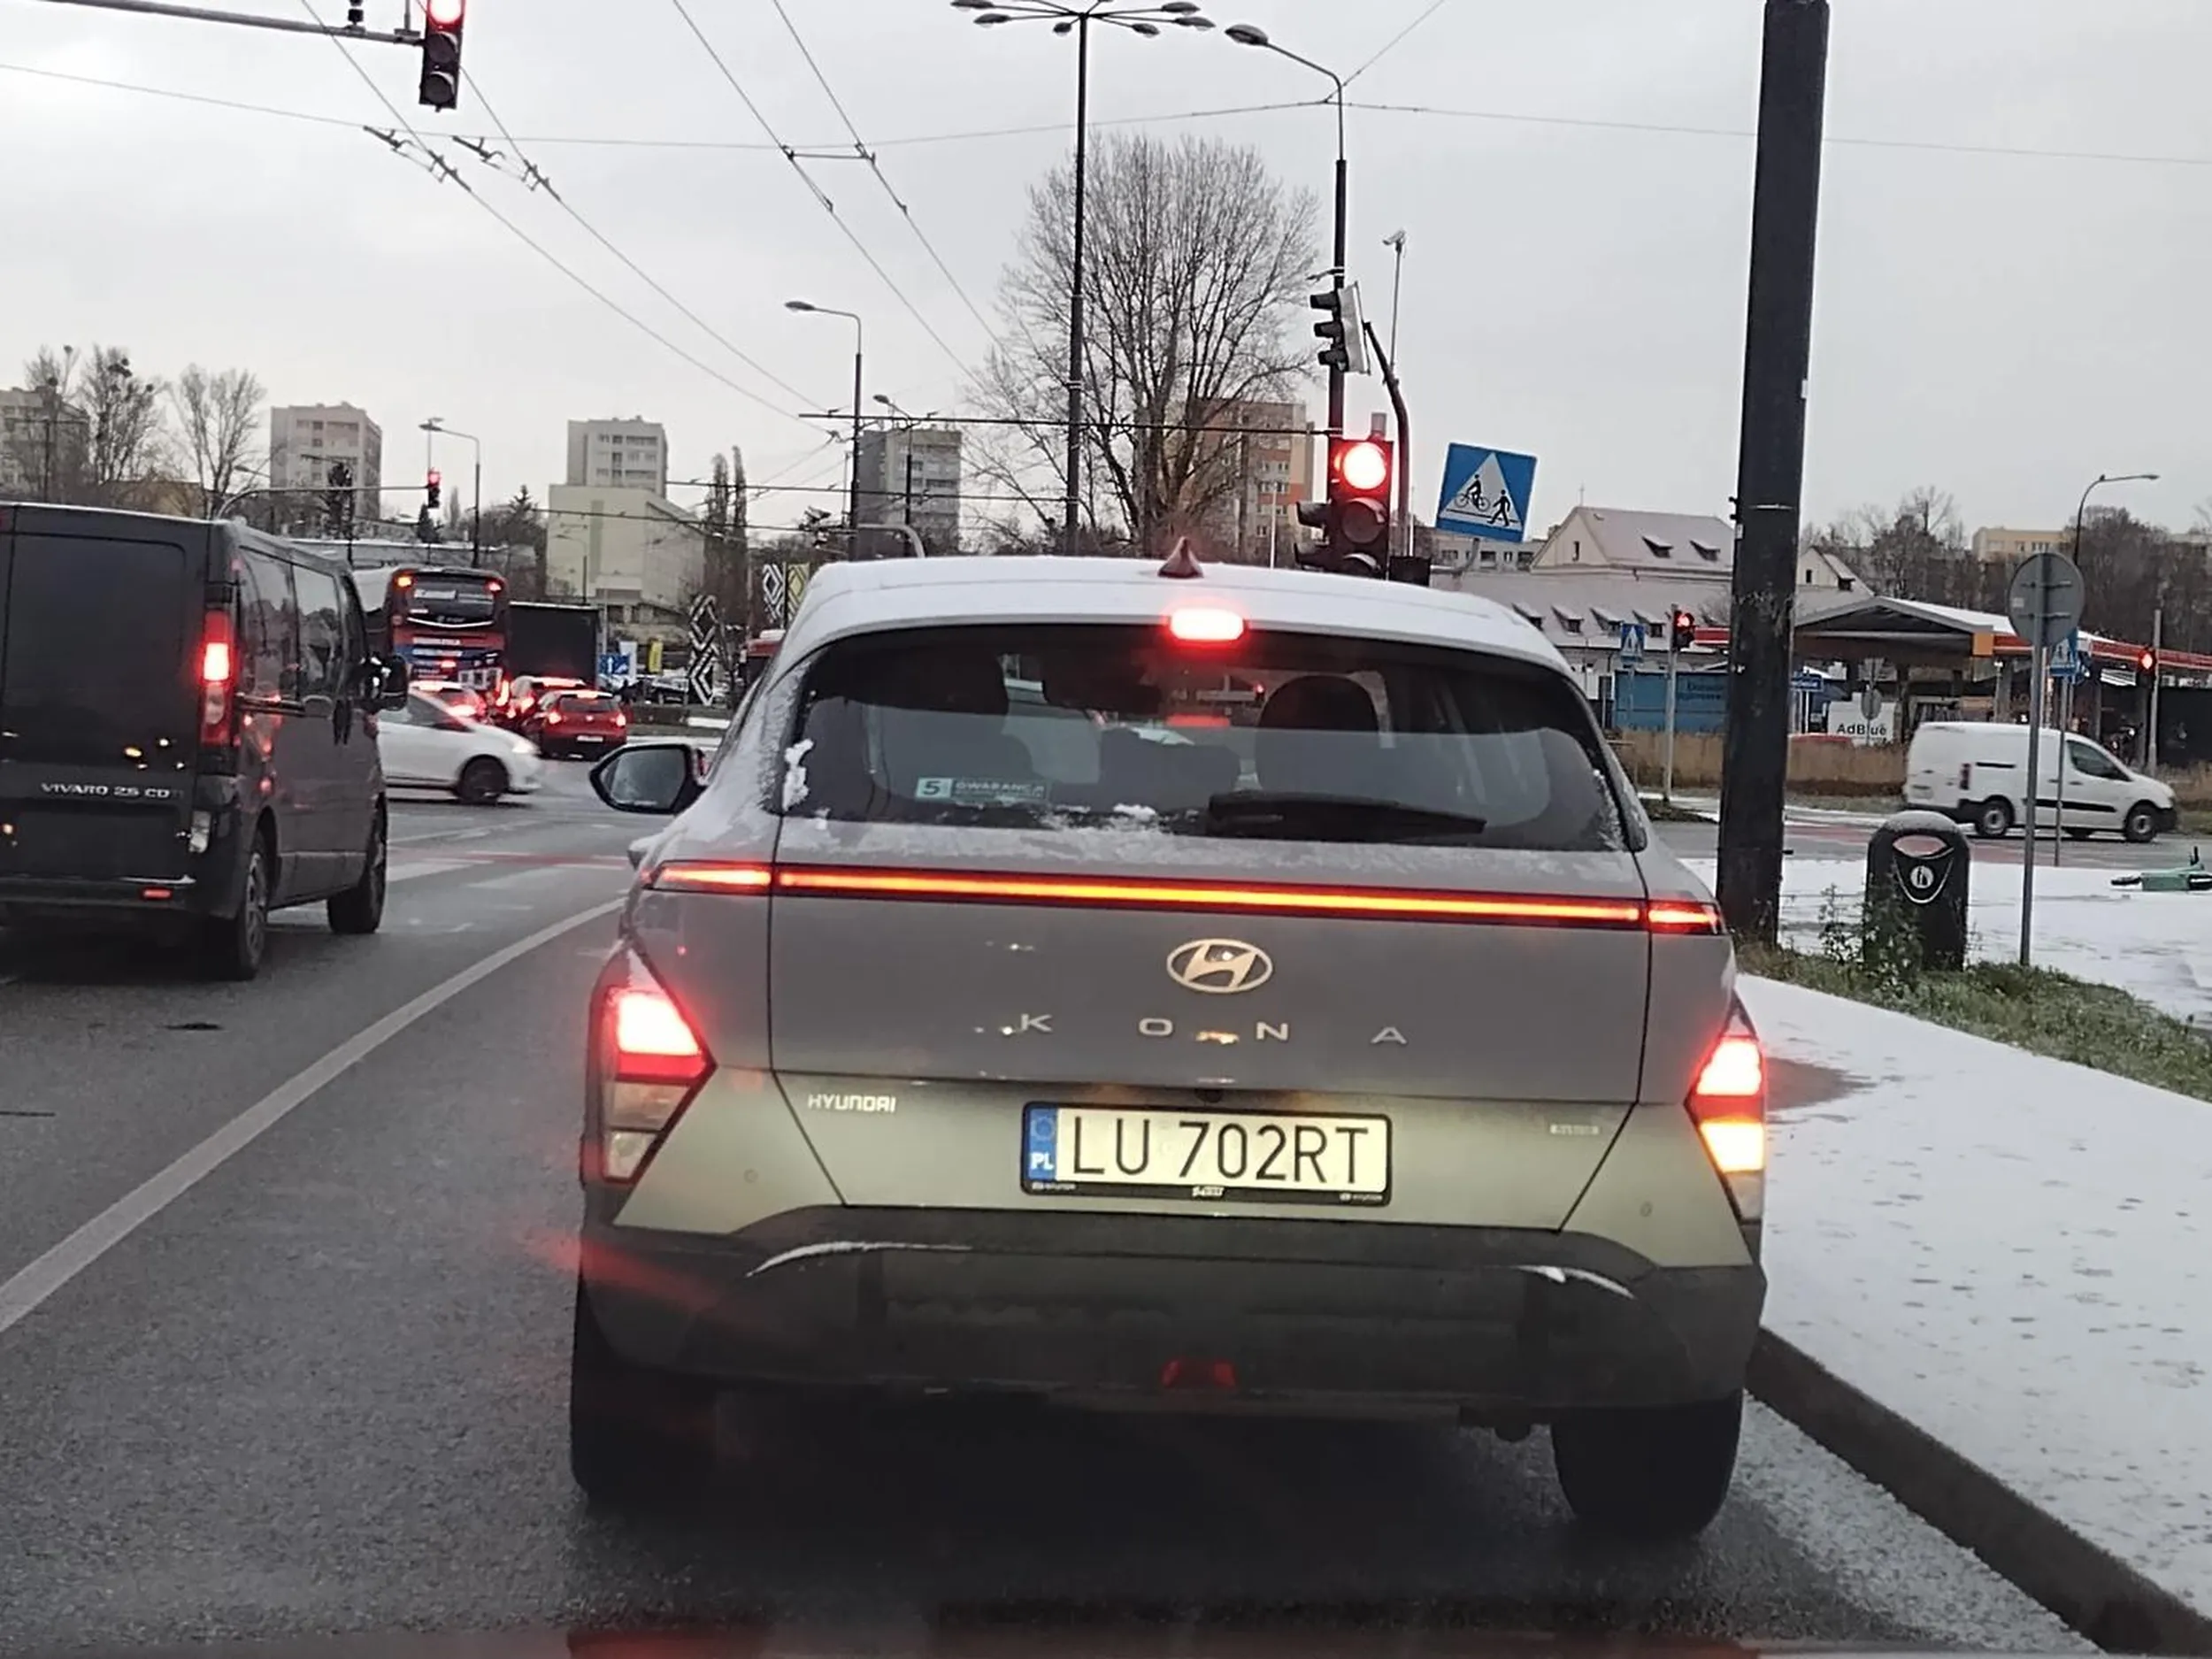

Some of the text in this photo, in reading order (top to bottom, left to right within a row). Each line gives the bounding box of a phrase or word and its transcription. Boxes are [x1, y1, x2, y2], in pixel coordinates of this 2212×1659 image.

[1837, 722, 1887, 735] AdBue
[41, 782, 109, 795] VIVARO
[923, 781, 941, 795] 5
[808, 1094, 896, 1113] HYUNDAI
[1073, 1117, 1369, 1184] LU 702RT
[1032, 1154, 1054, 1171] PL
